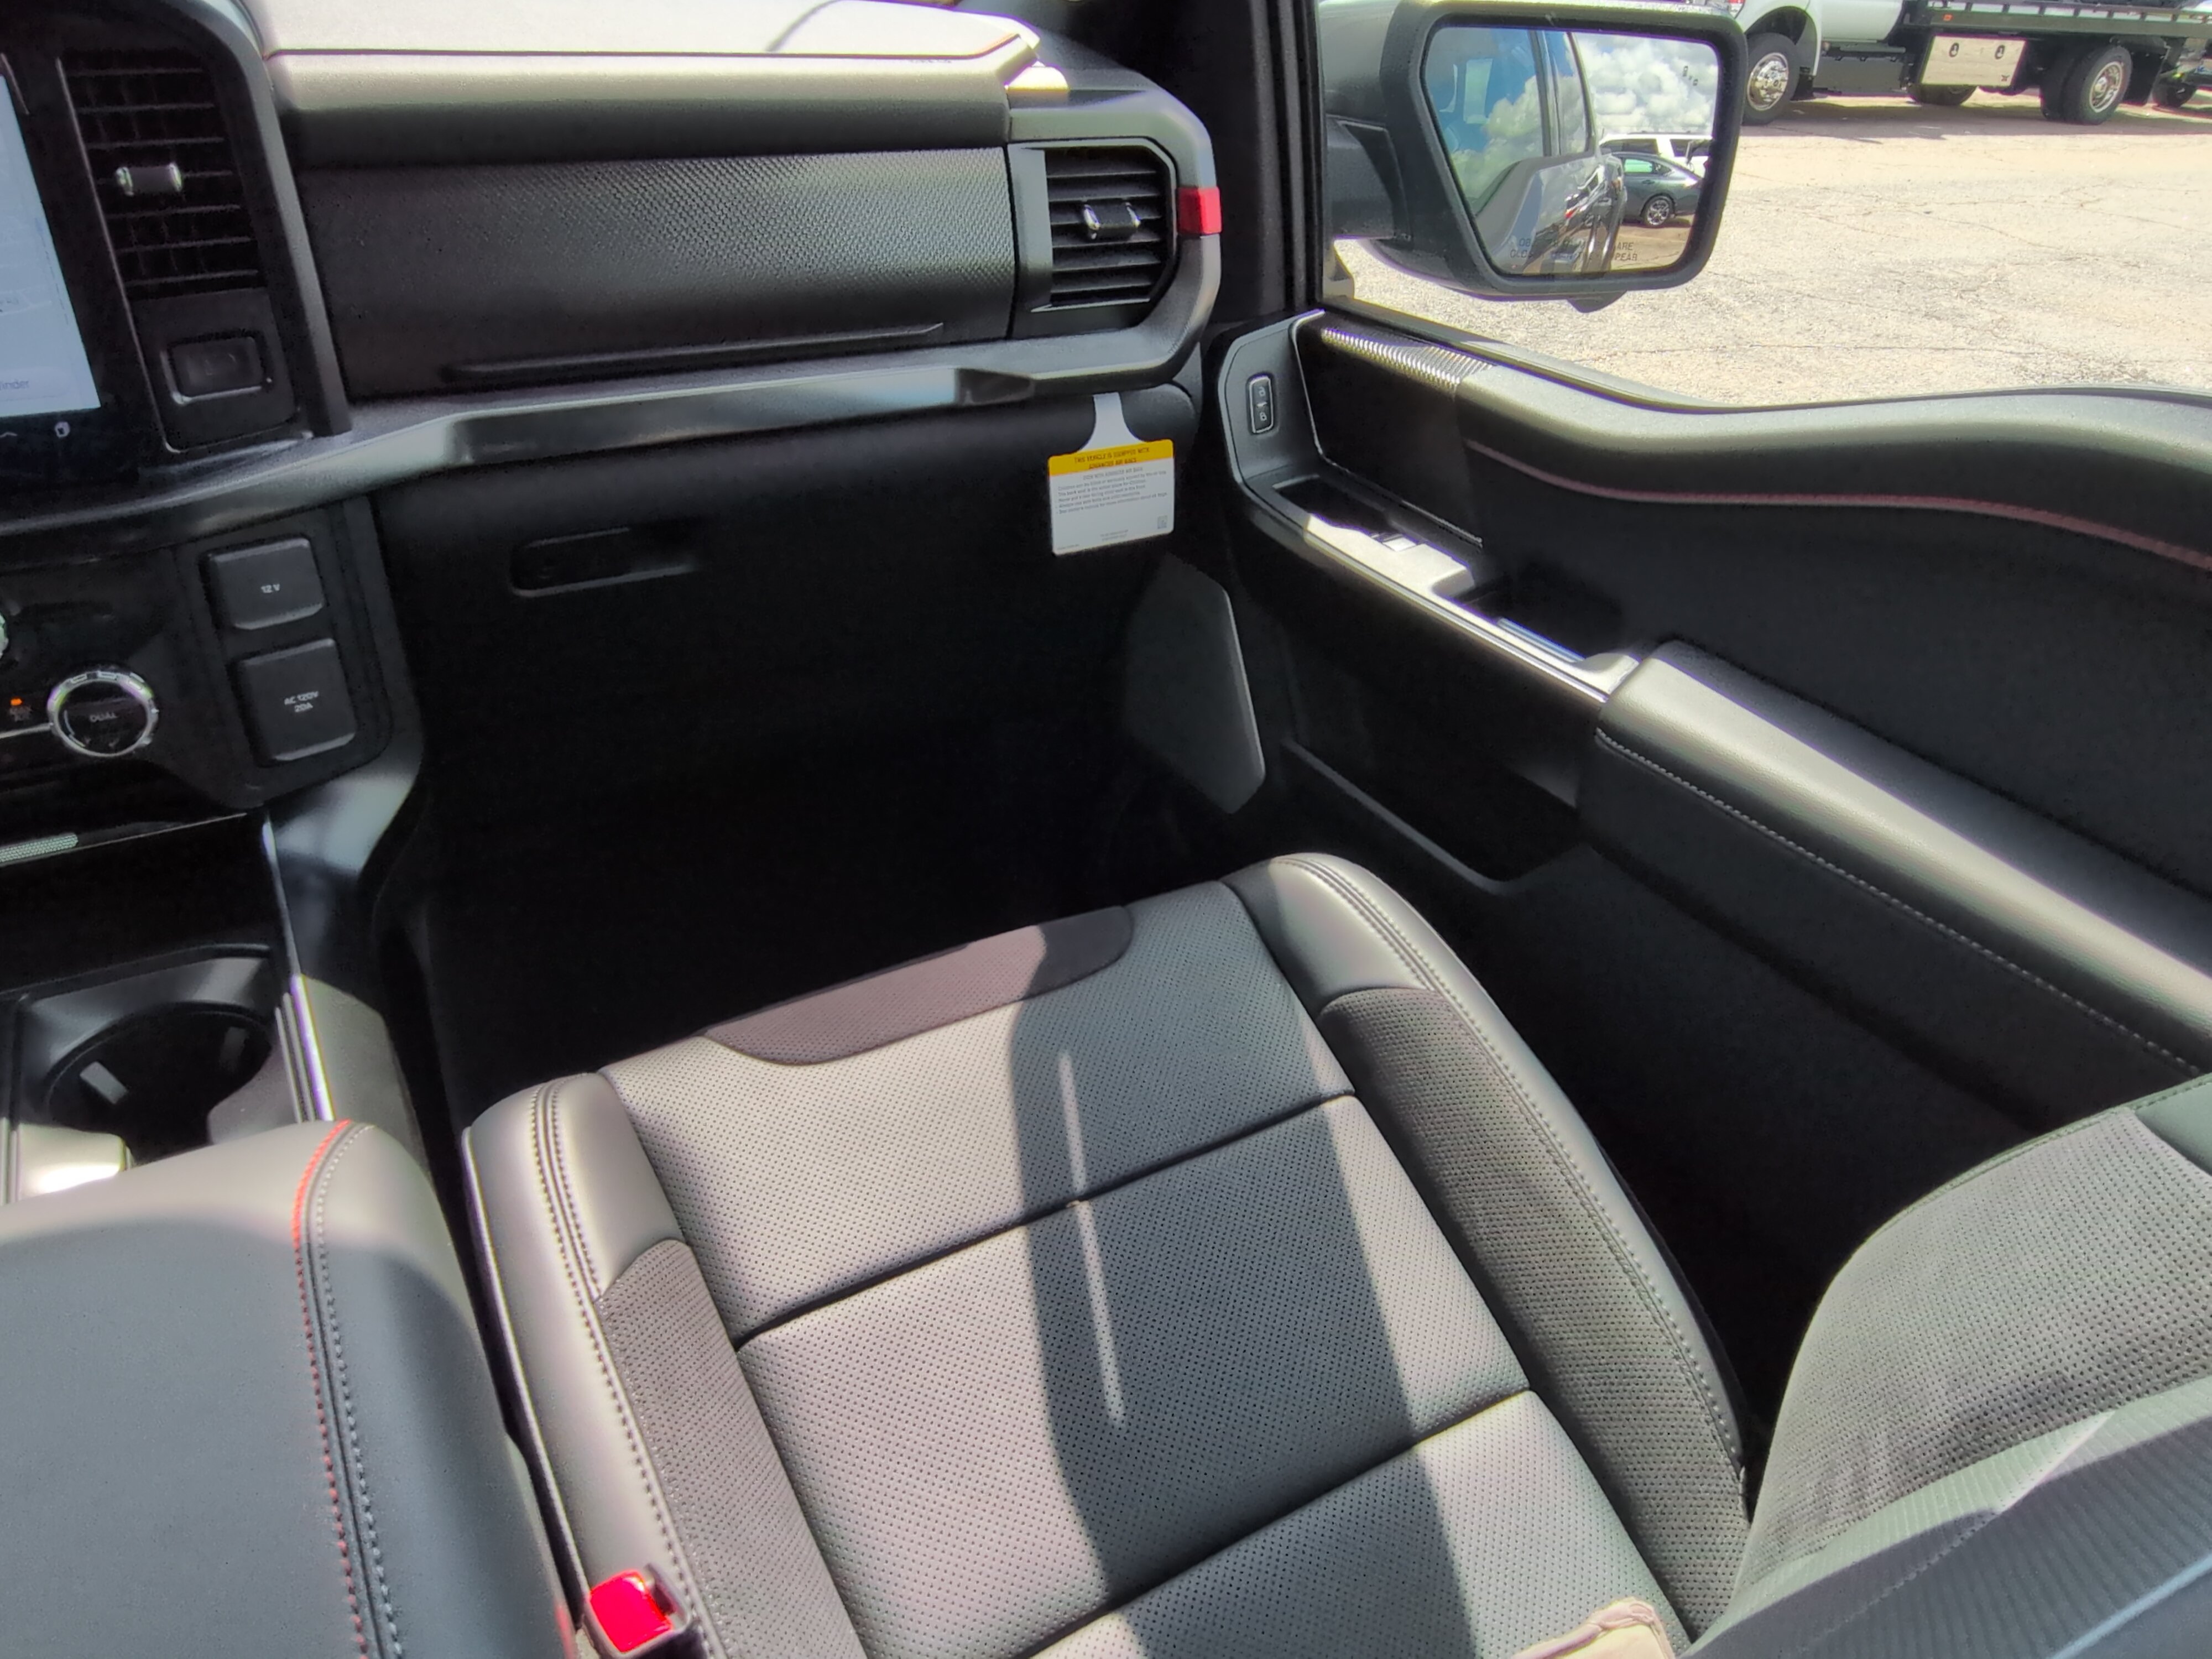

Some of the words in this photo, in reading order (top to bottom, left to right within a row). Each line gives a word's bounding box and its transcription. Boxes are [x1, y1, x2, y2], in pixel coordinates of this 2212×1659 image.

[1614, 252, 1638, 261] PEAR
[261, 585, 272, 593] 12
[284, 696, 296, 705] AC
